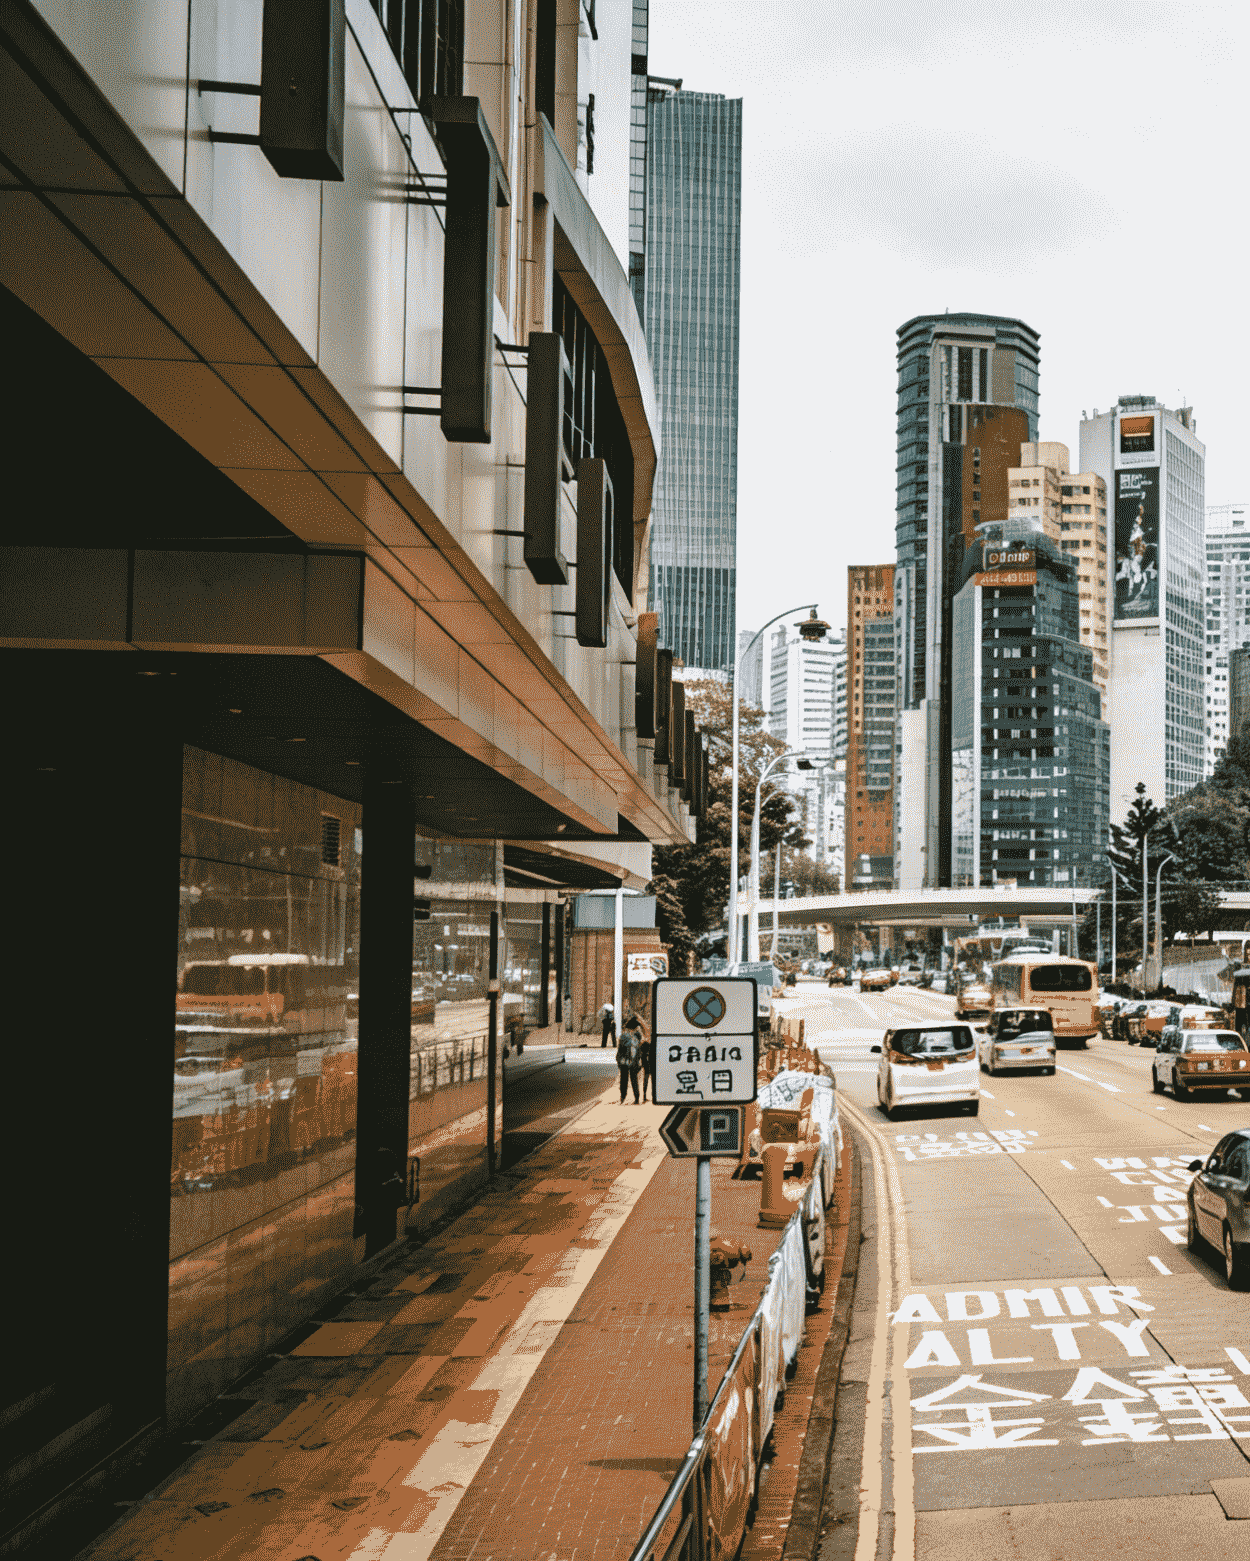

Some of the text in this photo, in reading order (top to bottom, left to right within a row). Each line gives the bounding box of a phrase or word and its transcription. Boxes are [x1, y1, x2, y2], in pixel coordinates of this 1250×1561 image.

[709, 1114, 731, 1146] P
[892, 1285, 1156, 1325] ADMIR
[903, 1319, 1152, 1369] ALTY
